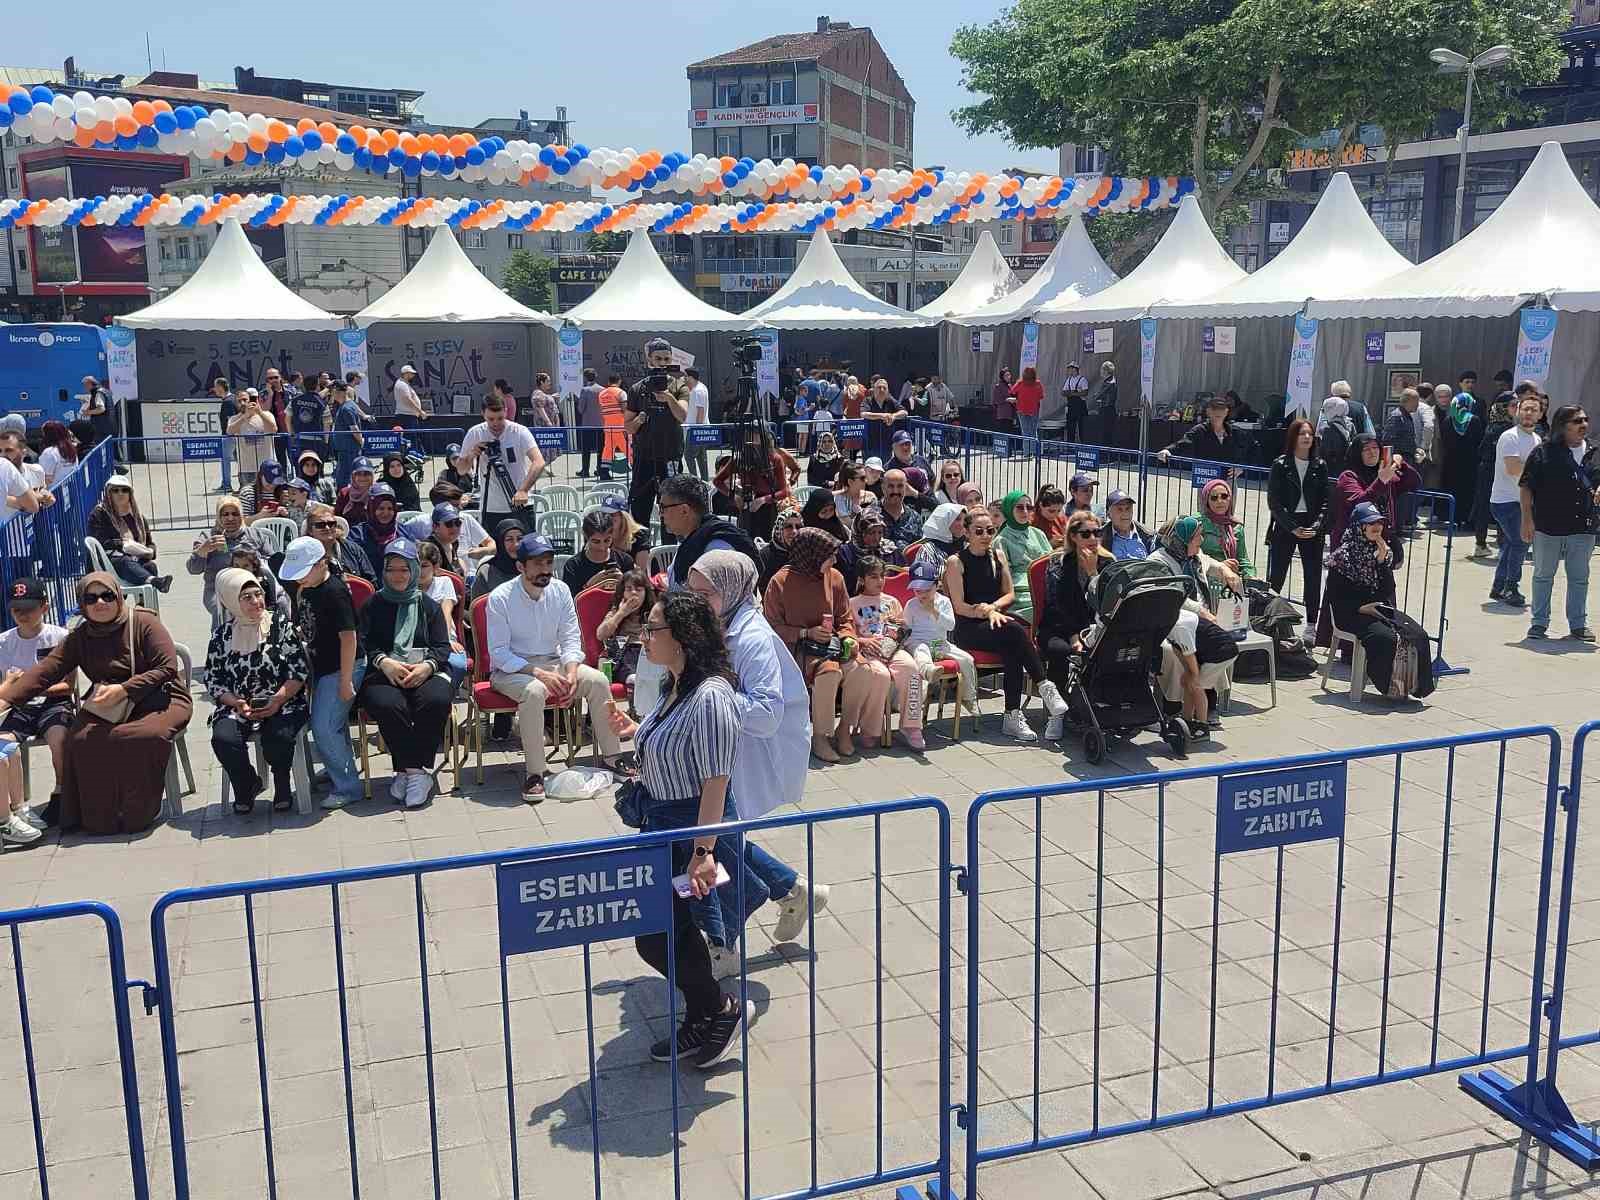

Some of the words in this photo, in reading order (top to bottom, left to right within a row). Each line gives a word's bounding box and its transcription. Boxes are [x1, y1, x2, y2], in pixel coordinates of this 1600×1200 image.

[560, 270, 586, 280] CAFE
[187, 412, 222, 434] ESE
[1234, 780, 1334, 810] ESENLER
[1244, 808, 1323, 836] ZABITA
[519, 864, 655, 904] ESENLER
[535, 898, 642, 934] ZABITA
